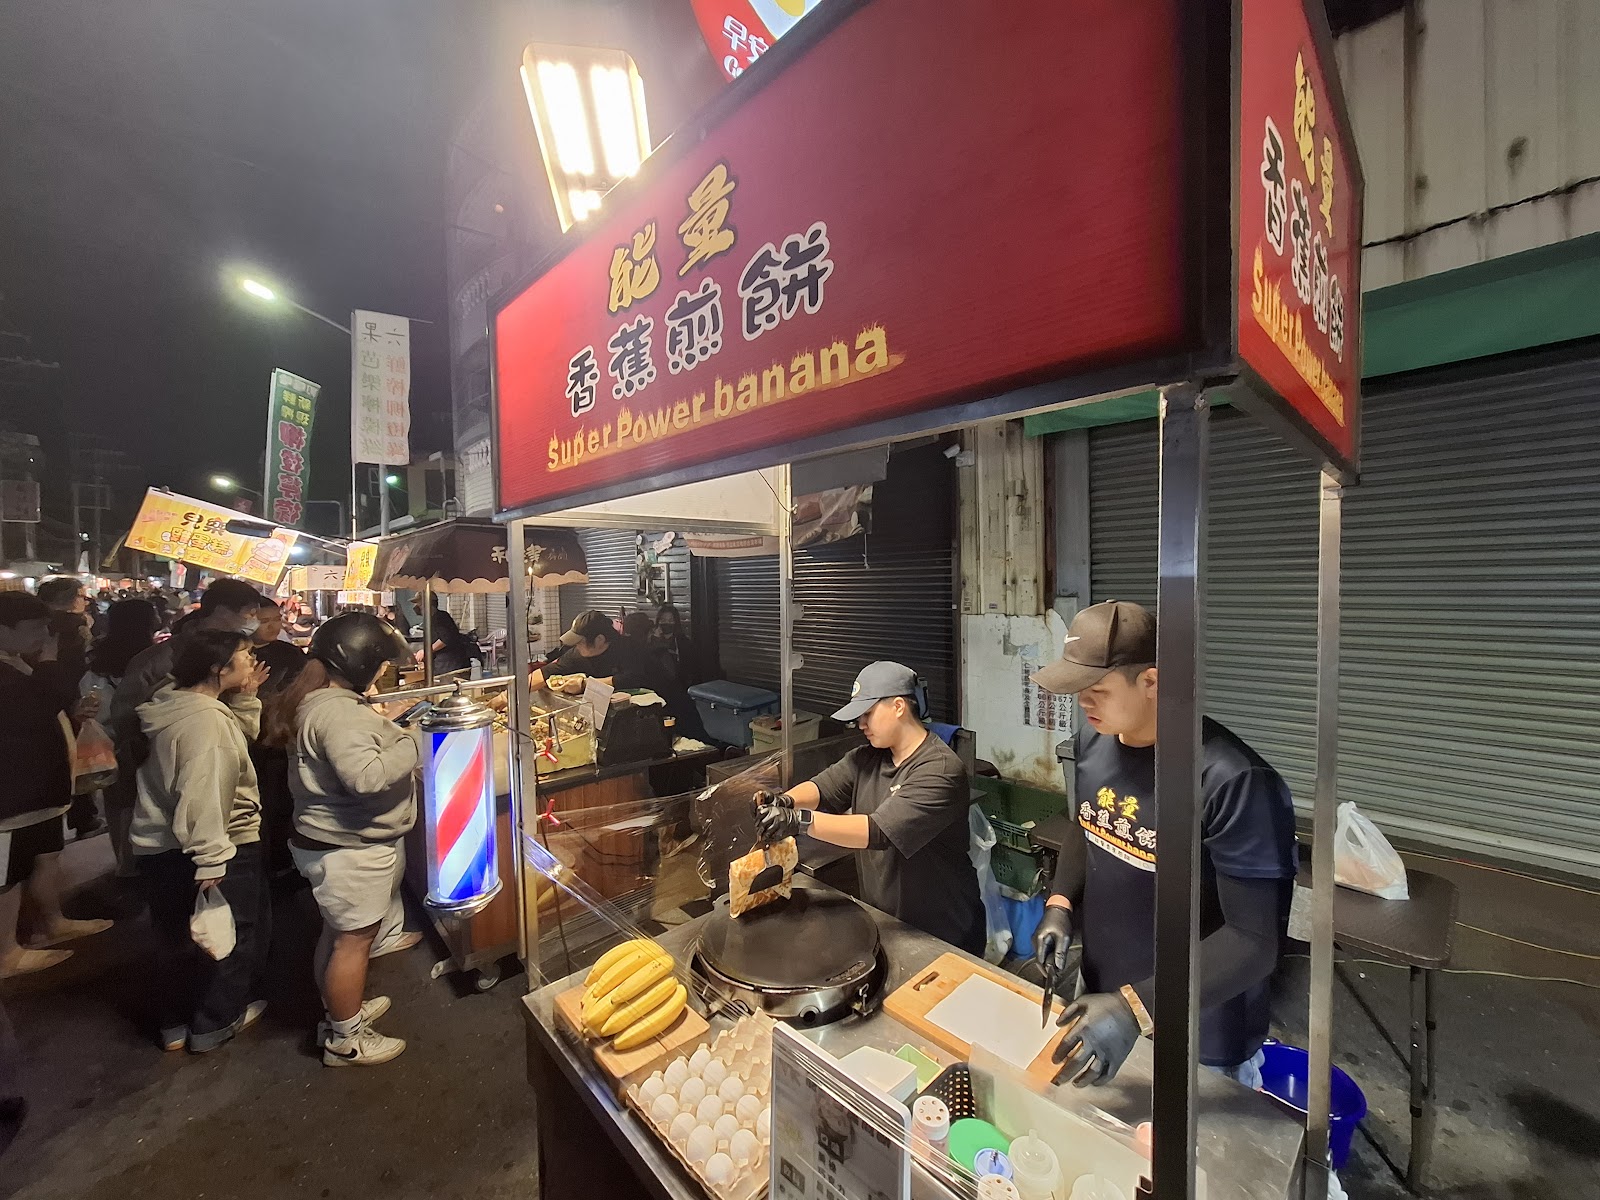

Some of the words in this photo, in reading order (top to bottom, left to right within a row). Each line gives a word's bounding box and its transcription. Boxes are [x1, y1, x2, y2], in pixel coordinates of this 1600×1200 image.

[608, 163, 736, 312] 能量
[1252, 242, 1295, 348] Super
[566, 221, 834, 417] 香蕉煎餅
[547, 424, 612, 470] Super
[615, 393, 706, 448] Power
[713, 322, 890, 419] banana
[1097, 786, 1140, 821] 能量
